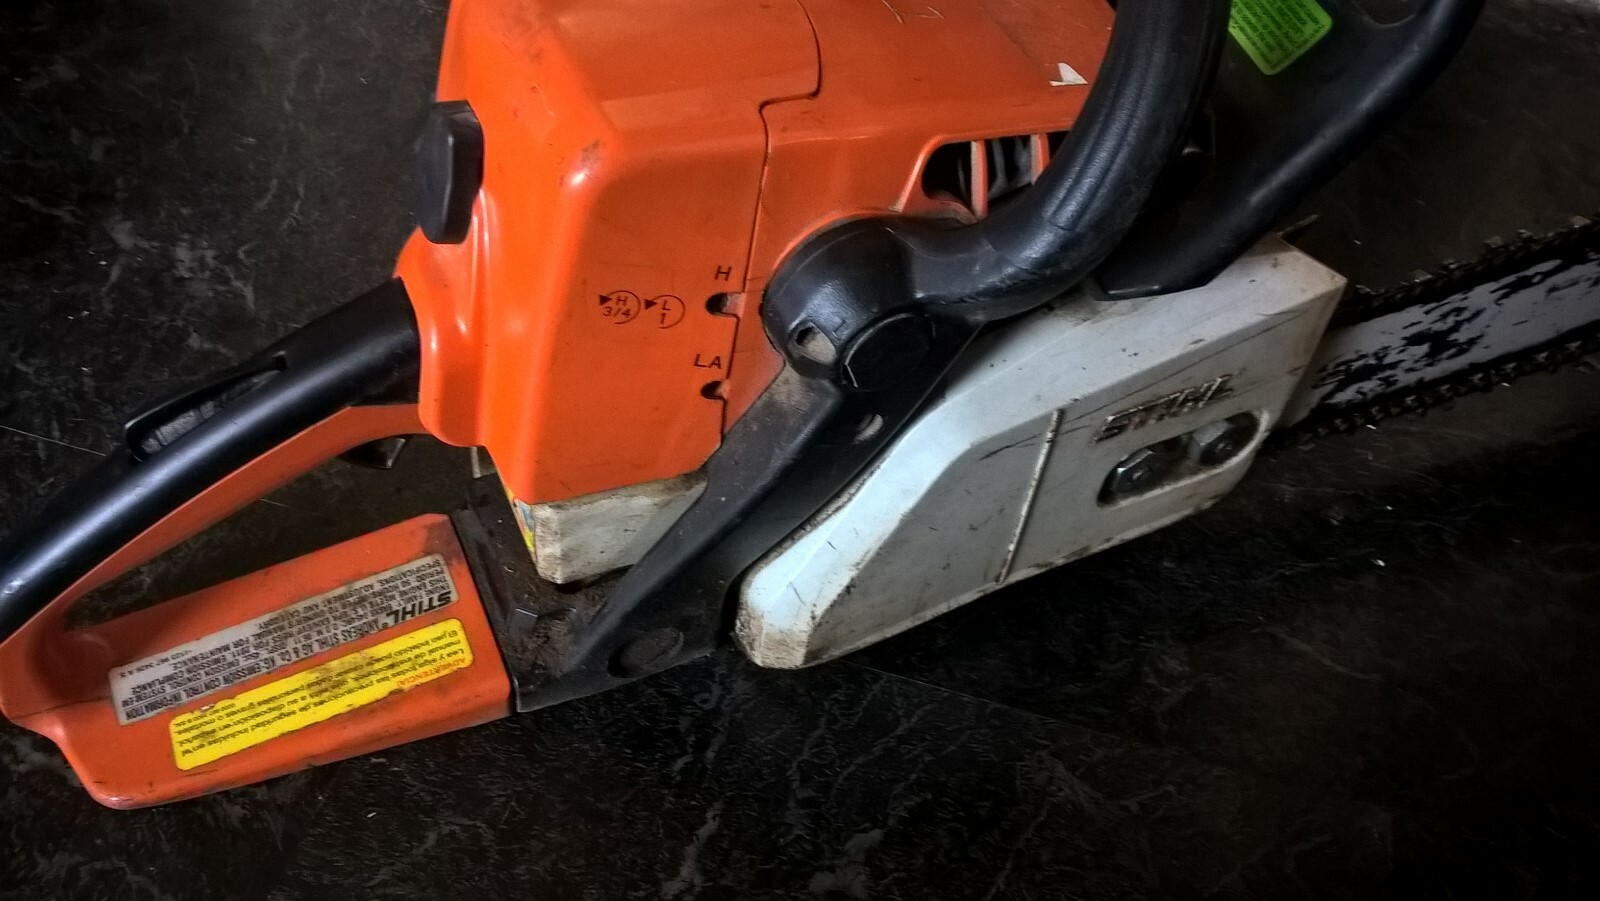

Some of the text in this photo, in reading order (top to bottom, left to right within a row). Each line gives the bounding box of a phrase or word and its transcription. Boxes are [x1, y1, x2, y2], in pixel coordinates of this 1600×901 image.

[714, 265, 732, 282] H
[615, 295, 628, 306] H
[662, 300, 672, 311] L
[602, 306, 632, 318] 3/4
[693, 353, 722, 369] LA
[1092, 374, 1234, 444] STIHL
[427, 574, 447, 587] THIS
[321, 583, 374, 607] ADJUSTMENT
[398, 582, 427, 598] ENGINE
[423, 582, 450, 598] ENGINE
[301, 602, 320, 615] AND
[368, 593, 396, 608] MEETS
[385, 590, 453, 625] STIHL
[250, 623, 286, 642] MANUAL
[340, 617, 380, 642] ANDREAS
[232, 636, 250, 649] FOR
[251, 638, 269, 651] FOR
[315, 632, 340, 651] STIHL
[392, 640, 429, 658] indebido
[427, 639, 461, 655] manual
[446, 647, 464, 658] Lea
[184, 654, 226, 675] EMISSION
[203, 658, 240, 678] EMISSION
[221, 662, 261, 685] EMISSION
[390, 665, 417, 679] todas
[130, 669, 184, 695] COMPLIANCE
[167, 672, 202, 691] CONTROL
[182, 677, 221, 699] CONTROL
[375, 675, 390, 685] las
[256, 684, 305, 708] personales
[312, 679, 374, 708] precauciones
[124, 691, 182, 720] INFORMATION
[223, 701, 255, 719] graves
[249, 708, 297, 731] seguridad
[206, 727, 249, 747] incluidas
